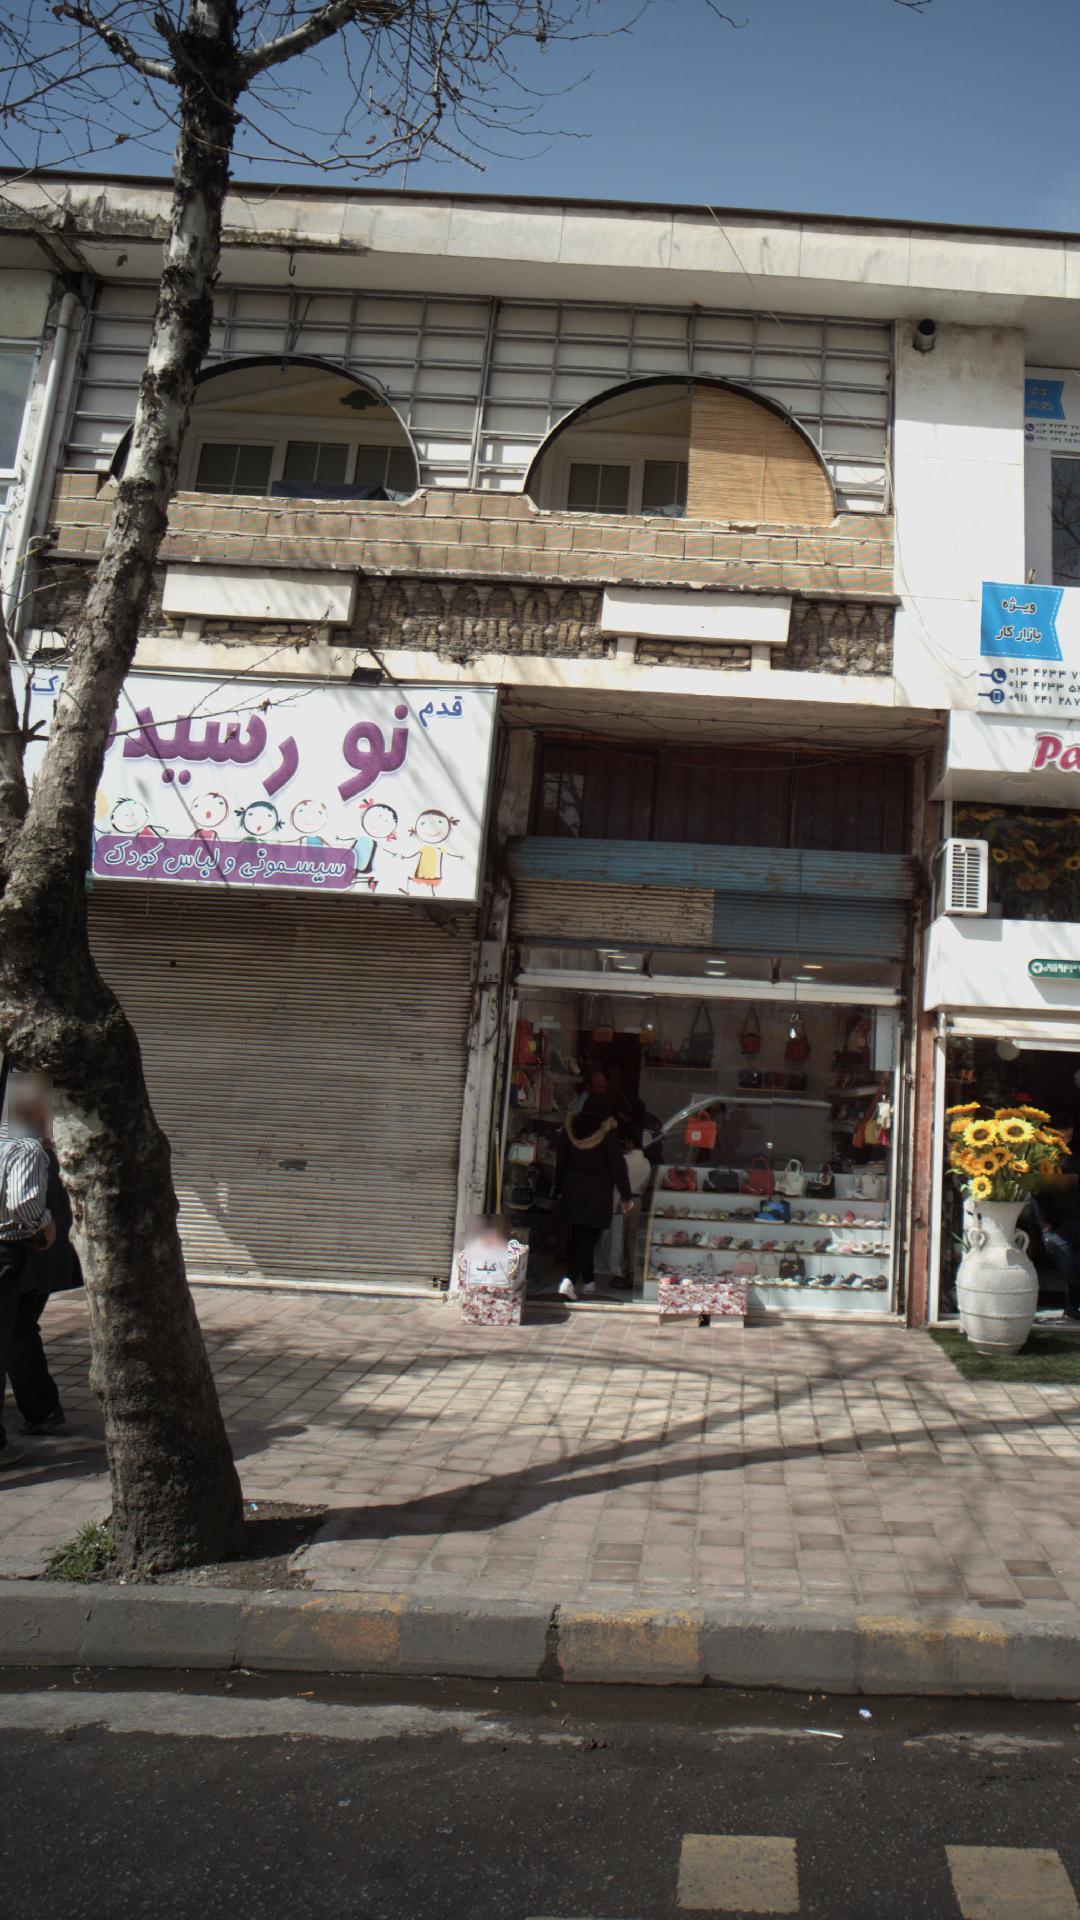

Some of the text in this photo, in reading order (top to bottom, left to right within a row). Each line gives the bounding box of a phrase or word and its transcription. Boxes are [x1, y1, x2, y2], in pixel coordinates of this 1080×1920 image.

[1002, 597, 1036, 614] ویژه
[995, 626, 1042, 644] بازار کار
[419, 695, 463, 728] قدم
[338, 703, 409, 802] نو
[104, 840, 346, 882] سیسمونی و لباس کودک
[476, 1261, 497, 1274] کیف
